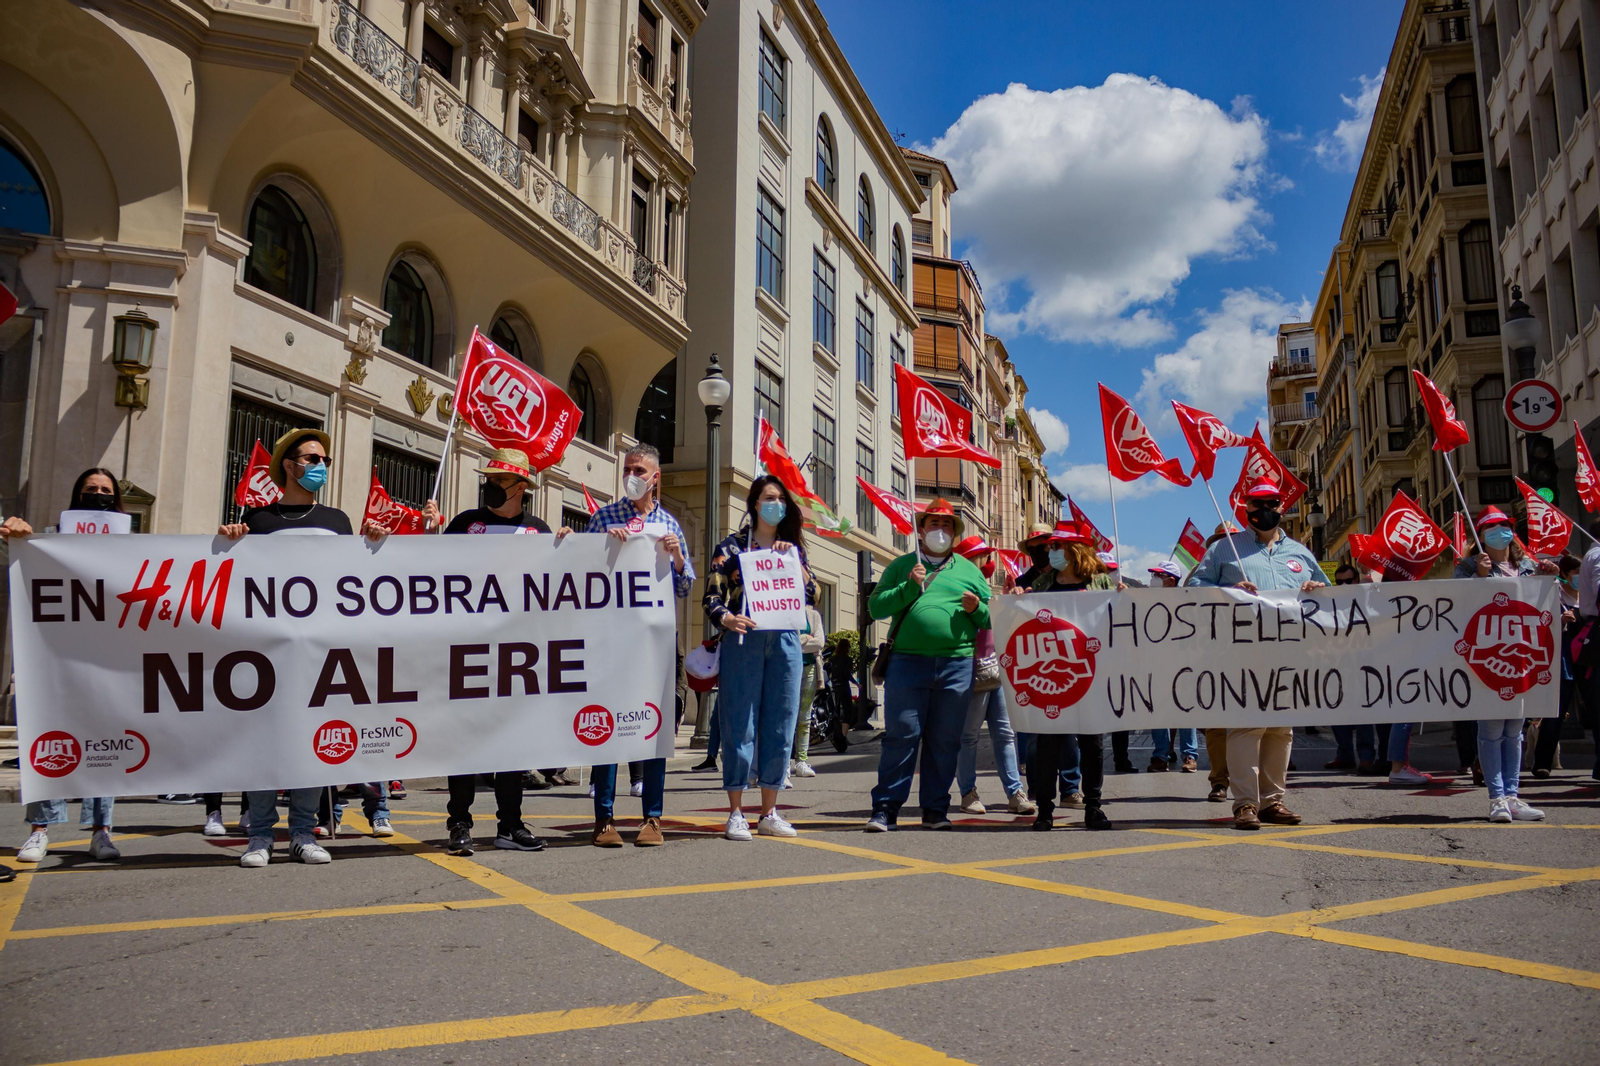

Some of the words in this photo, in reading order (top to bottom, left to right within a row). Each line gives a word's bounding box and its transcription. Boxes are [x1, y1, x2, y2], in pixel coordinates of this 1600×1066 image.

[480, 364, 542, 425] UGT
[533, 409, 570, 460] www.ugt.es
[76, 521, 97, 534] NO
[101, 523, 110, 534] A
[755, 559, 773, 571] NO
[777, 558, 785, 569] A
[752, 579, 769, 592] UN
[772, 577, 796, 591] ERE
[31, 578, 106, 623] EN
[116, 558, 234, 631] H&M
[244, 576, 318, 618] NO
[335, 574, 510, 617] SOBRA
[523, 571, 664, 612] NADIE.
[752, 598, 801, 613] INJUSTO
[1107, 596, 1371, 648] HOSTELERIA
[1388, 595, 1459, 635] POR
[1476, 613, 1542, 647] UGT
[1015, 628, 1078, 667] UGT
[142, 650, 276, 713] NO
[308, 646, 418, 708] AL
[449, 639, 587, 700] ERE
[1107, 671, 1154, 718] UN
[1172, 665, 1344, 712] CONVENIO
[1360, 665, 1472, 709] DIGNO
[578, 711, 609, 728] UGT
[616, 709, 651, 723] FeSMC
[319, 727, 351, 744] UGT
[360, 725, 403, 739] FeSMC
[36, 739, 75, 755] UGT
[85, 738, 134, 751] FeSMC
